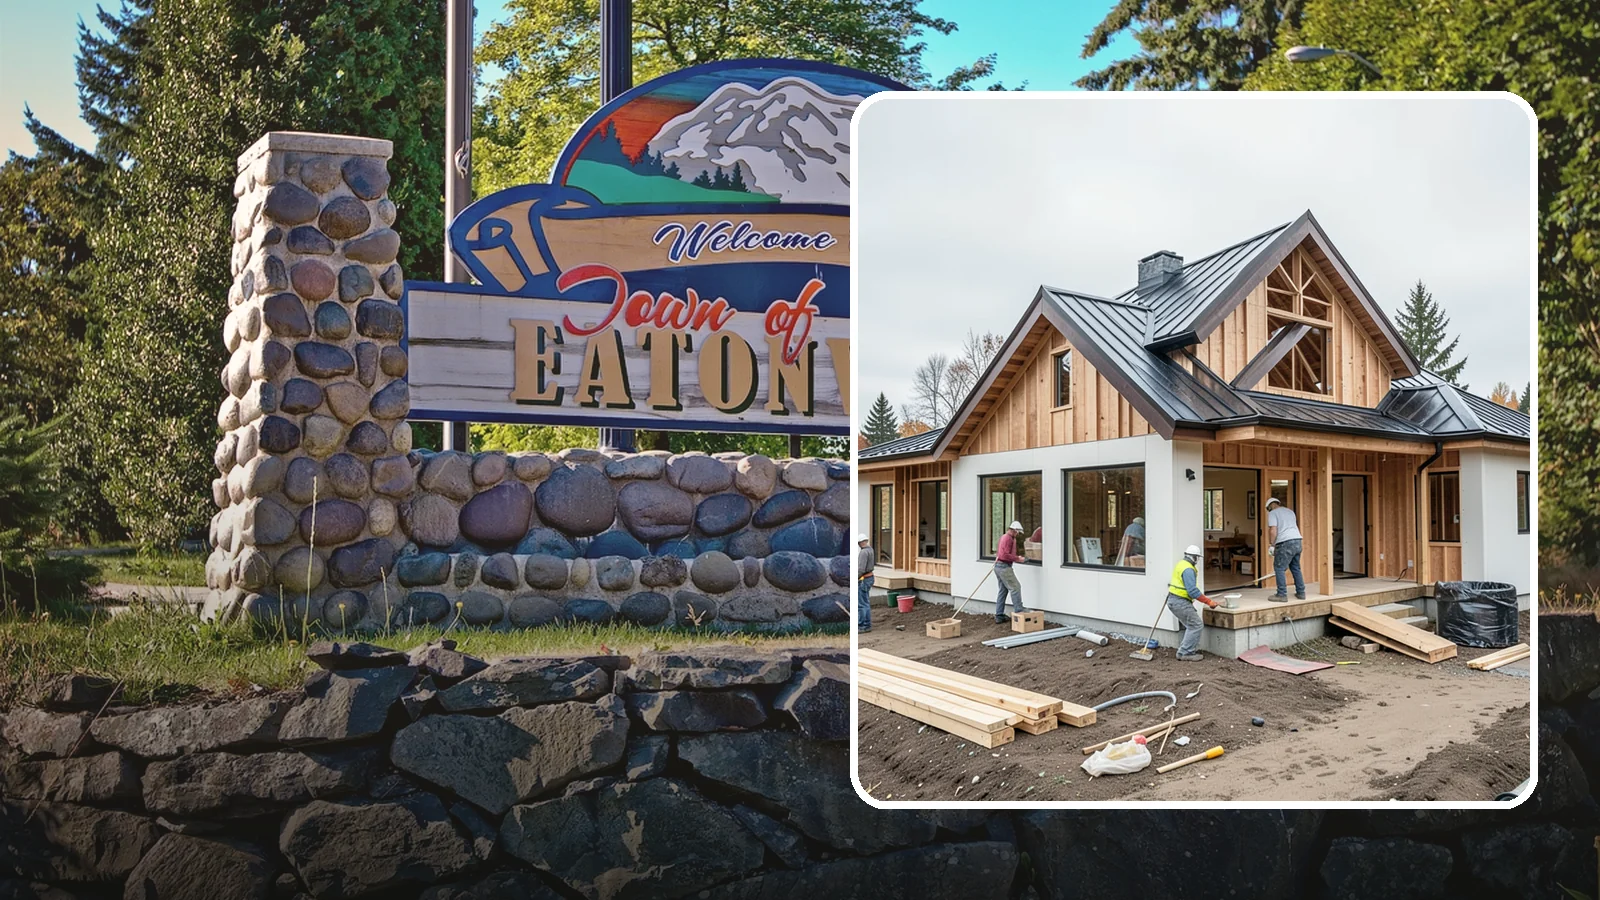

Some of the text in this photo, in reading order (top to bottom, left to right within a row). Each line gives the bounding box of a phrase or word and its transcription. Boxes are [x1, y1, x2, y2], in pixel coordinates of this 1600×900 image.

[653, 221, 836, 263] Welcome
[557, 263, 826, 366] Town of
